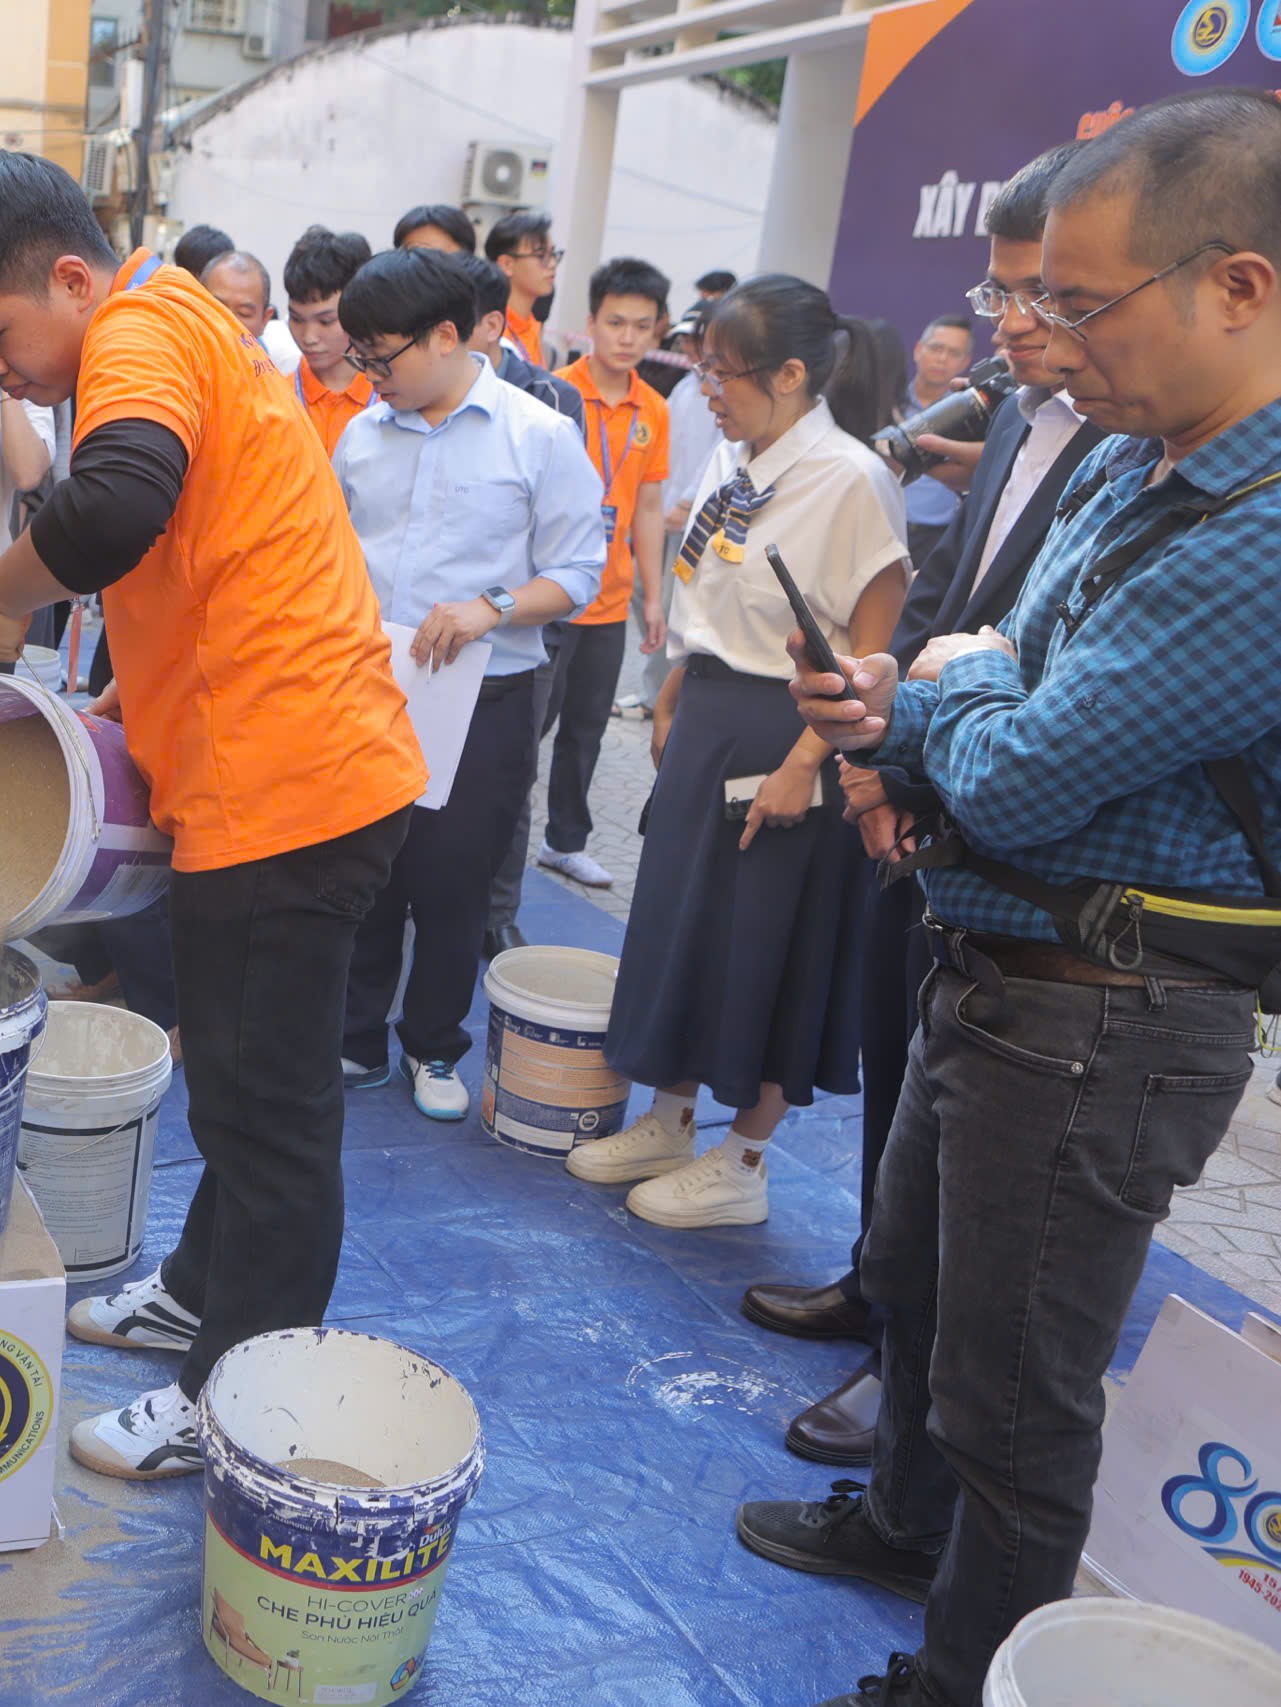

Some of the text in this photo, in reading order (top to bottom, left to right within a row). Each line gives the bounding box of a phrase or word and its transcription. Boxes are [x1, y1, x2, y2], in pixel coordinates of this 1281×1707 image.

[912, 170, 977, 238] XÂY
[259, 1528, 453, 1583] MAXILITE
[257, 1595, 299, 1623] CHE
[307, 1593, 408, 1613] HI-COVER
